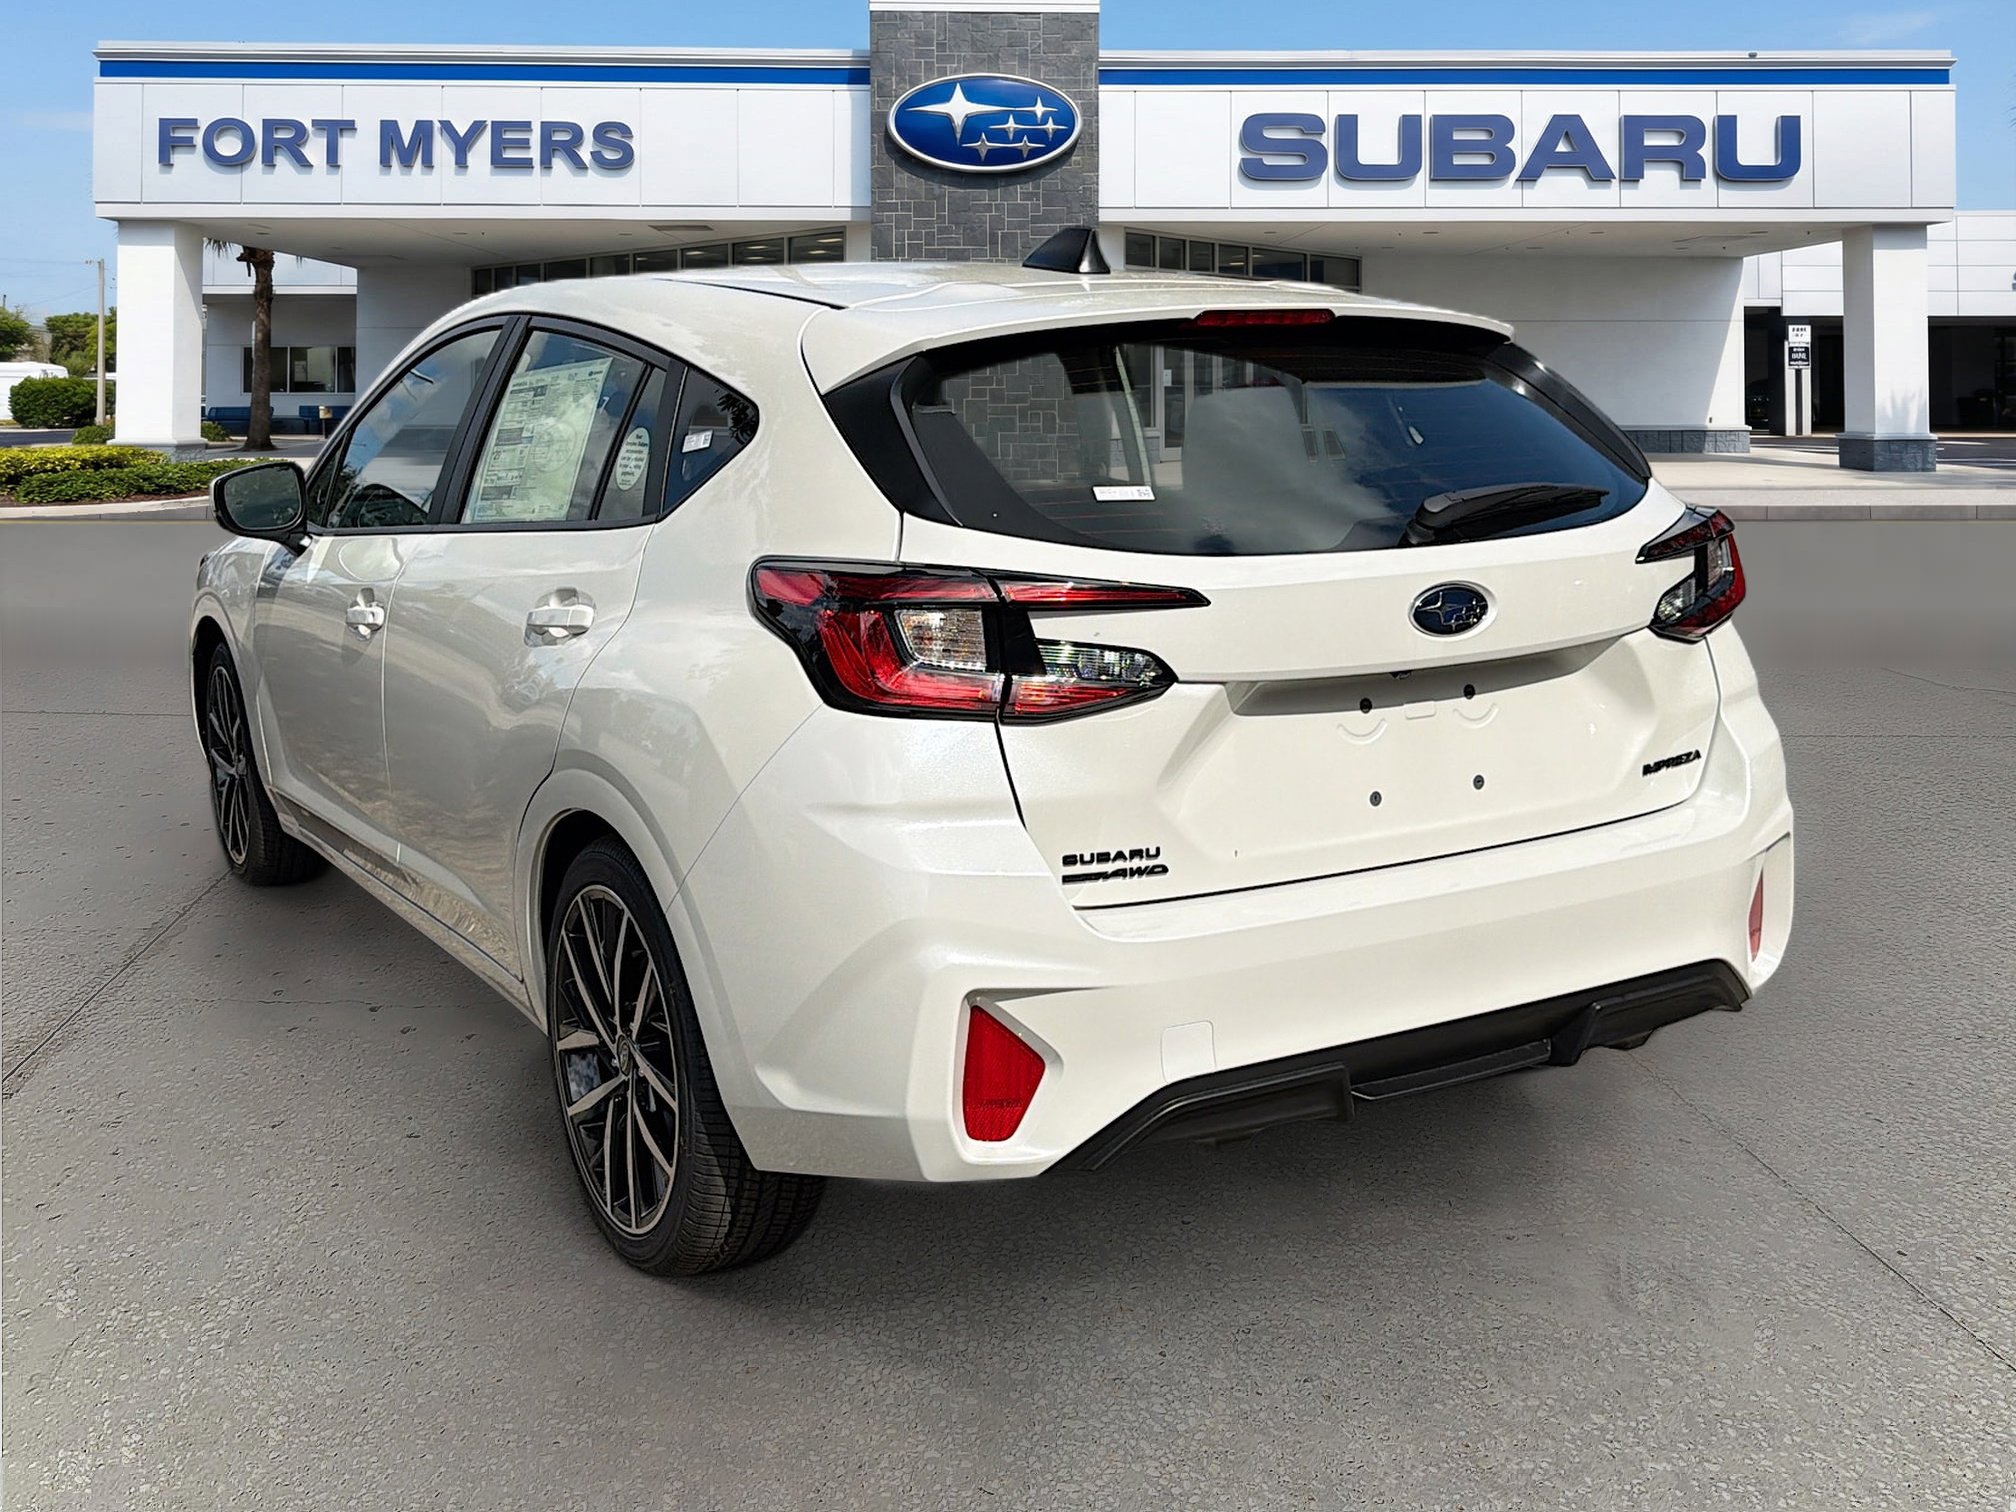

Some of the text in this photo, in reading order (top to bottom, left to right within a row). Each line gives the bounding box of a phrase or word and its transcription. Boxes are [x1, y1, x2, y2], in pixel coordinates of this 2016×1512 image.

[157, 117, 636, 170] FORT MYERS
[1239, 112, 1802, 182] SUBARU
[1642, 749, 1702, 777] IMPREZA
[1062, 846, 1161, 866] SUBARU
[1105, 864, 1169, 881] AWD
